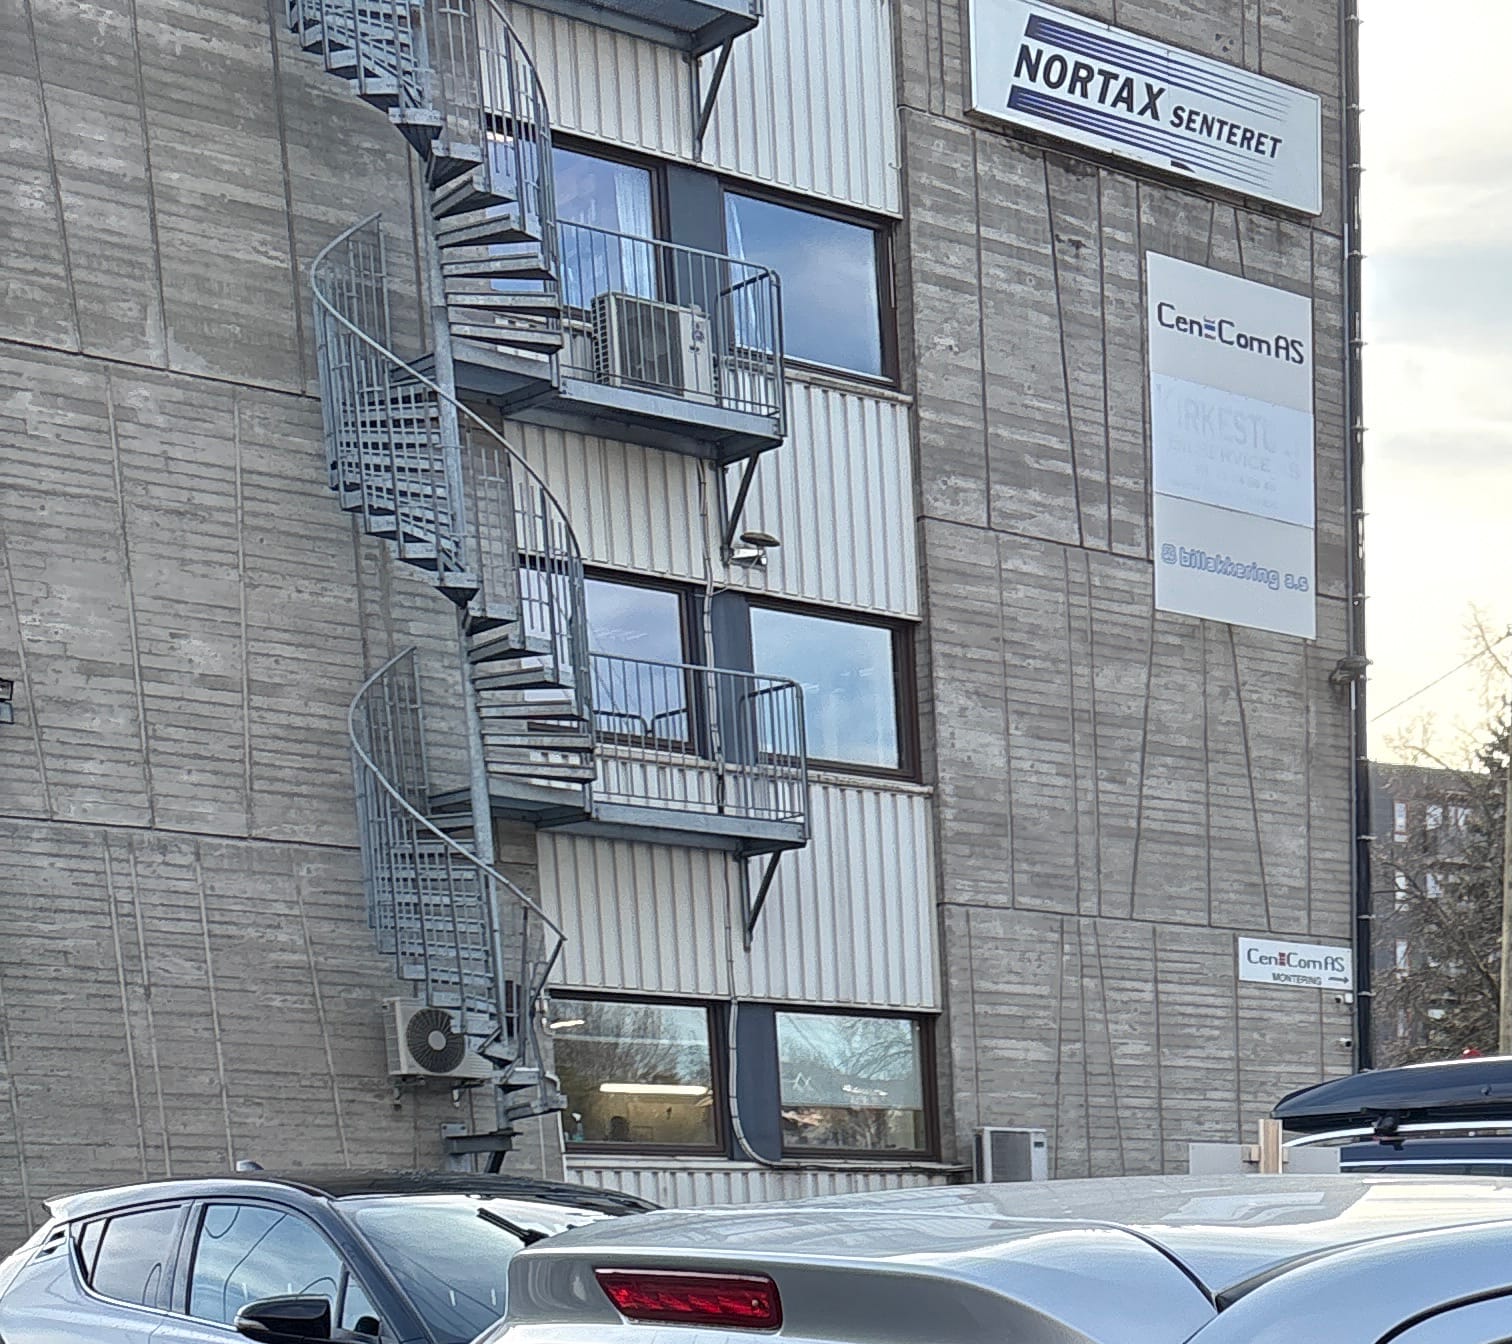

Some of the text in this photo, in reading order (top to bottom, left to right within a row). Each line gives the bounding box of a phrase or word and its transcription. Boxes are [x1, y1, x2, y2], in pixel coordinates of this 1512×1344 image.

[1013, 44, 1283, 159] NORTAX SENTERET
[1179, 547, 1280, 590] billakkering
